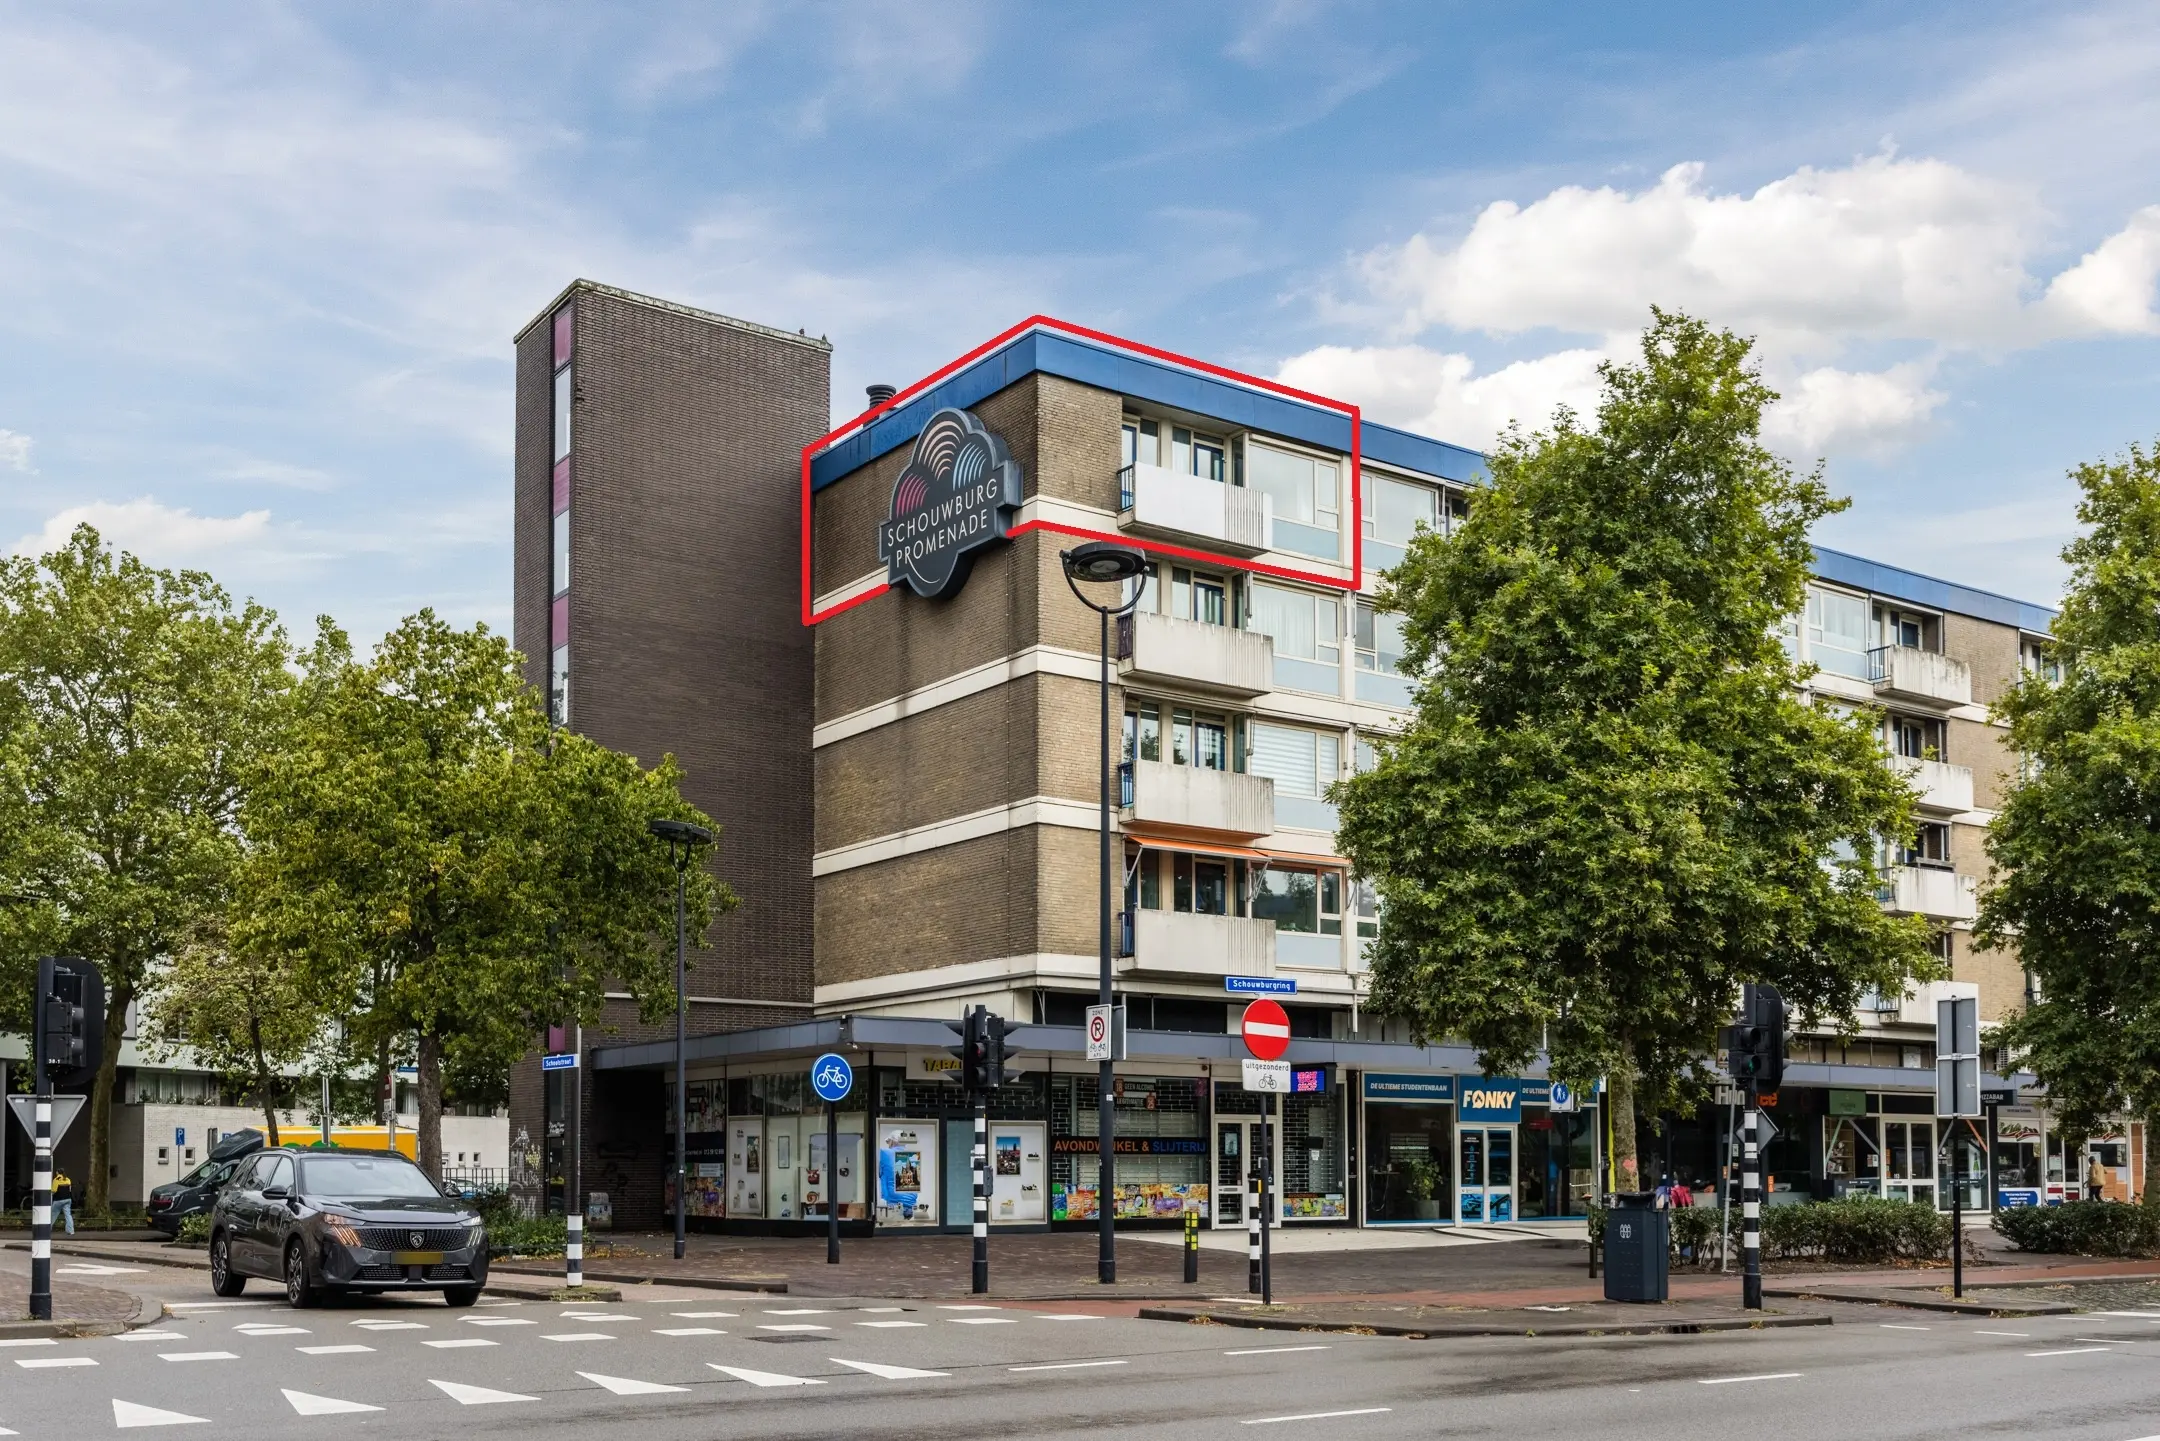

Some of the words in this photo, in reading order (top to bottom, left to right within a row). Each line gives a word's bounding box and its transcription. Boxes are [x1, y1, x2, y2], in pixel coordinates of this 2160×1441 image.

[887, 478, 998, 547] SCHOUWBURG
[895, 508, 988, 572] PROMENADE
[1233, 979, 1291, 991] Schouwburgring
[923, 1057, 963, 1073] TABA
[1245, 1061, 1290, 1072] uitgezonderd
[1370, 1082, 1377, 1090] DE
[1378, 1083, 1401, 1091] ULTIEME
[1401, 1083, 1448, 1092] STUDENTENBAAN
[1522, 1087, 1529, 1095] DE
[1462, 1089, 1517, 1109] FONKY
[1714, 1085, 1746, 1106] Hun
[1981, 1093, 2004, 1101] IZZABAR
[1054, 1140, 1139, 1152] AVONDWKEL
[1141, 1140, 1150, 1152] &
[1152, 1140, 1206, 1153] SLIJTERIJ
